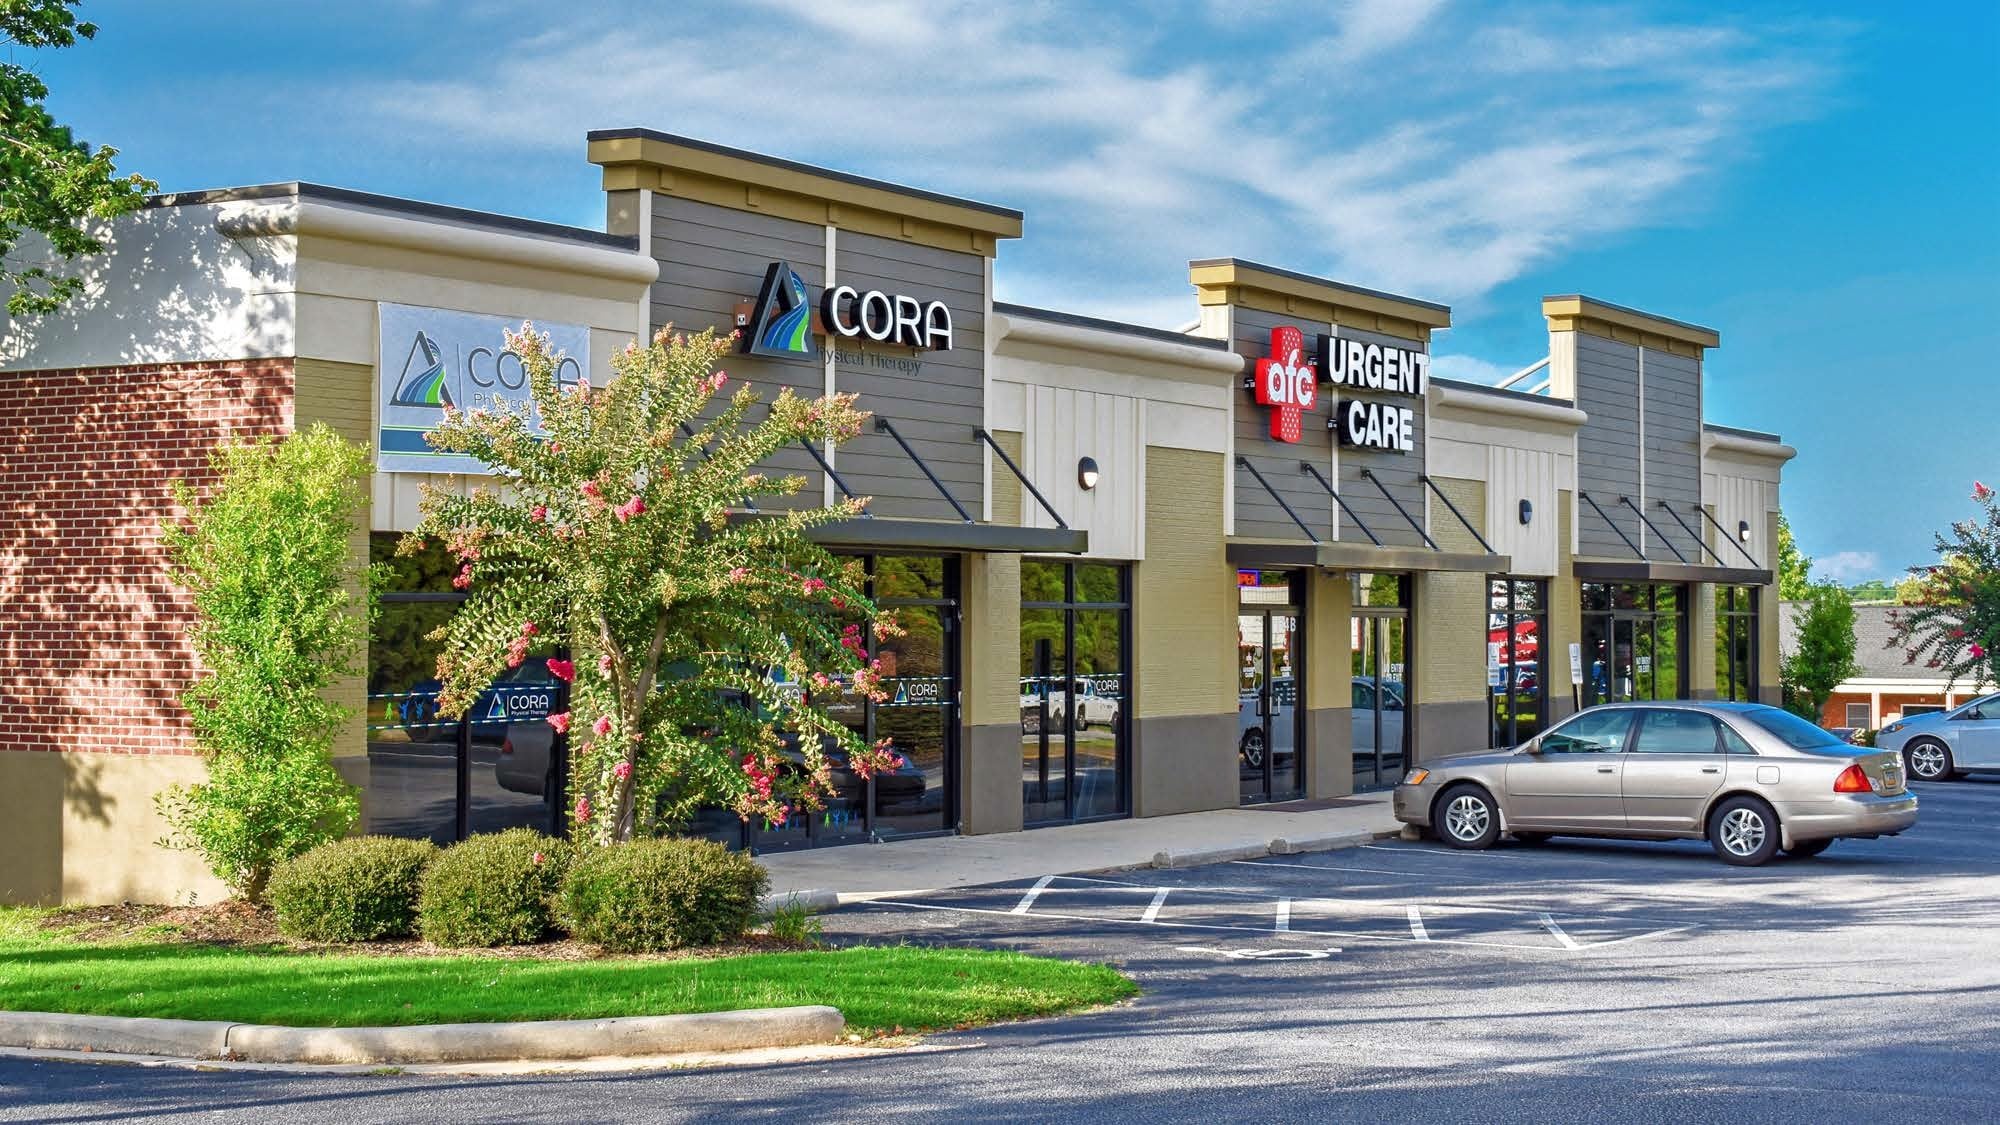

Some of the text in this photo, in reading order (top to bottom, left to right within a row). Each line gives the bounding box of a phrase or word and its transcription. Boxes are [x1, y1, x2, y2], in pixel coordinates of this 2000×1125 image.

[831, 285, 953, 350] CORA
[468, 347, 582, 394] COA
[870, 352, 921, 376] Therapy
[1267, 349, 1313, 406] afc
[1329, 337, 1429, 395] URGENT
[1349, 400, 1413, 451] CARE
[510, 694, 549, 709] CORA
[910, 683, 938, 696] CORA
[1096, 679, 1119, 691] CORA
